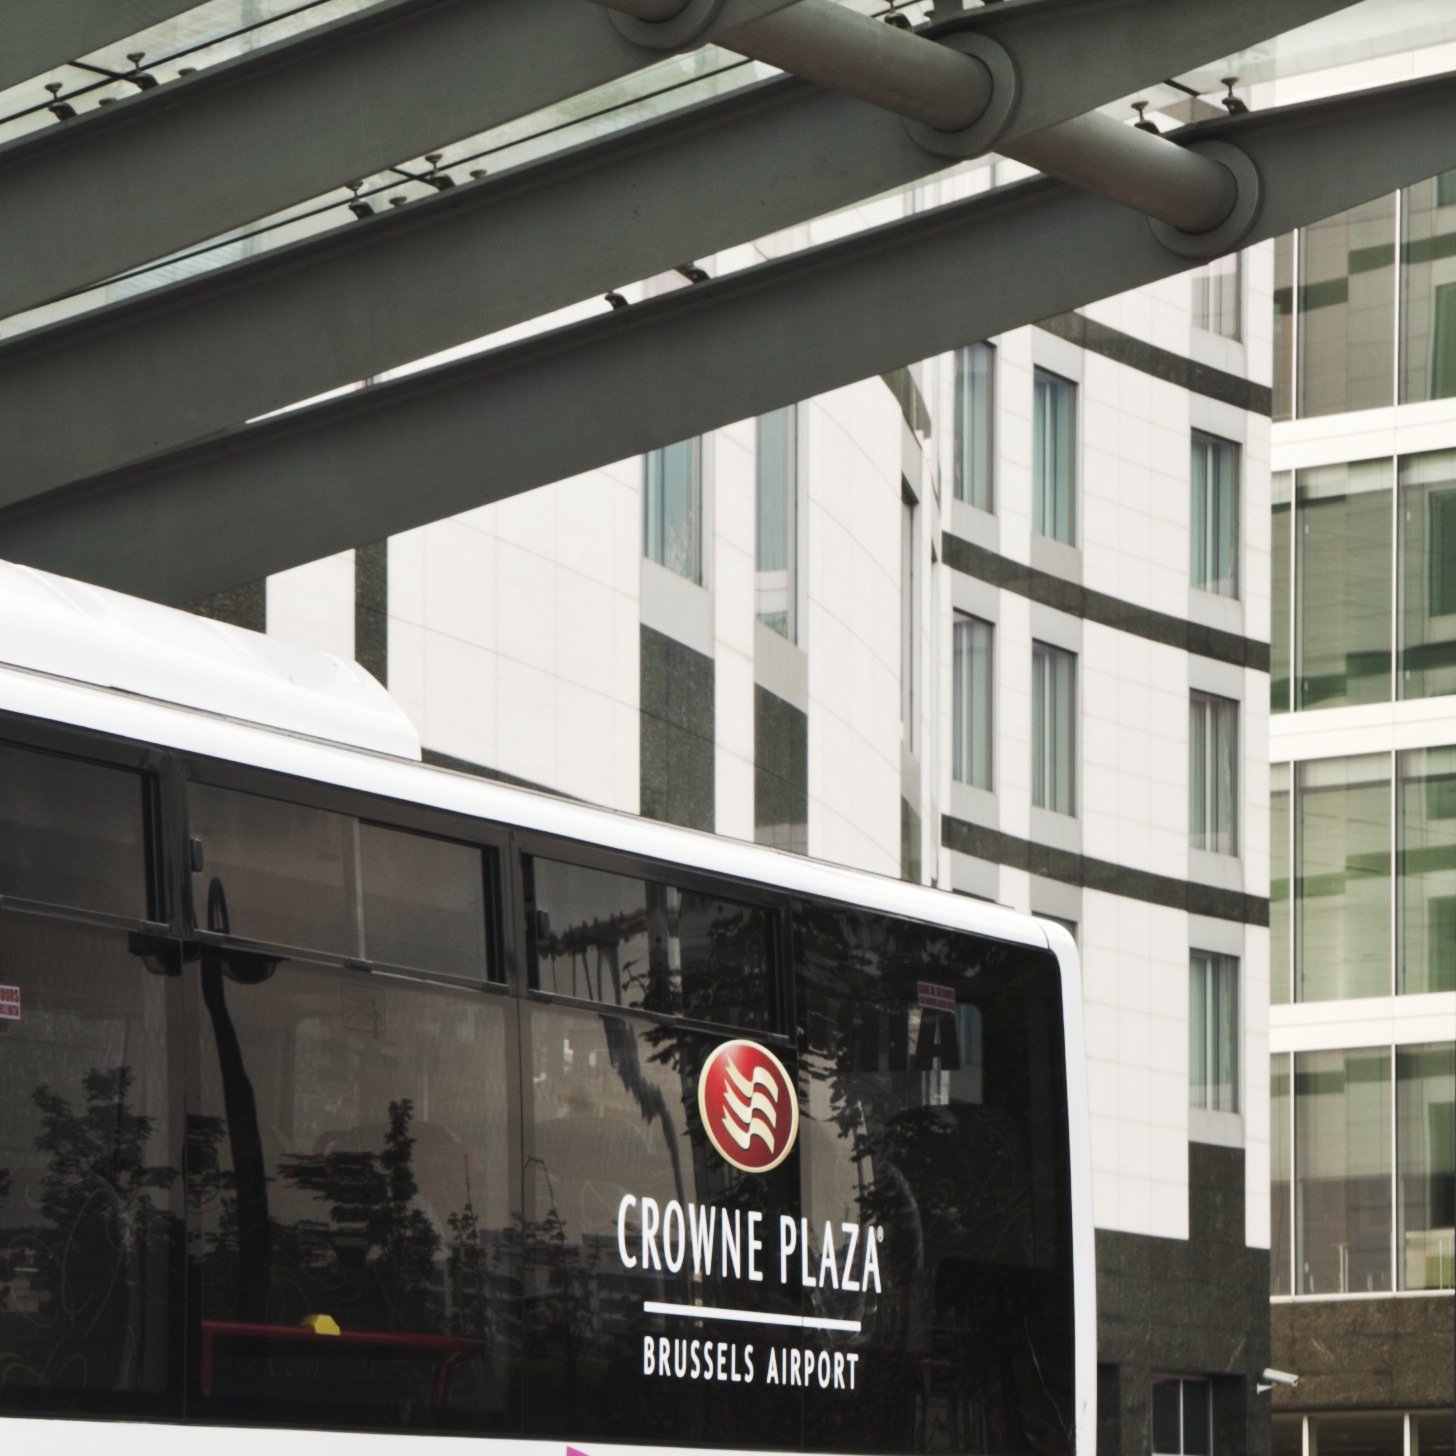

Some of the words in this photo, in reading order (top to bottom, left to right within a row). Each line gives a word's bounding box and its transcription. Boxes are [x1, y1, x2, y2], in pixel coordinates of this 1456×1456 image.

[617, 1193, 763, 1282] CROWNE
[643, 1335, 754, 1383] BRUSSELS
[766, 1347, 859, 1390] AIRPORT
